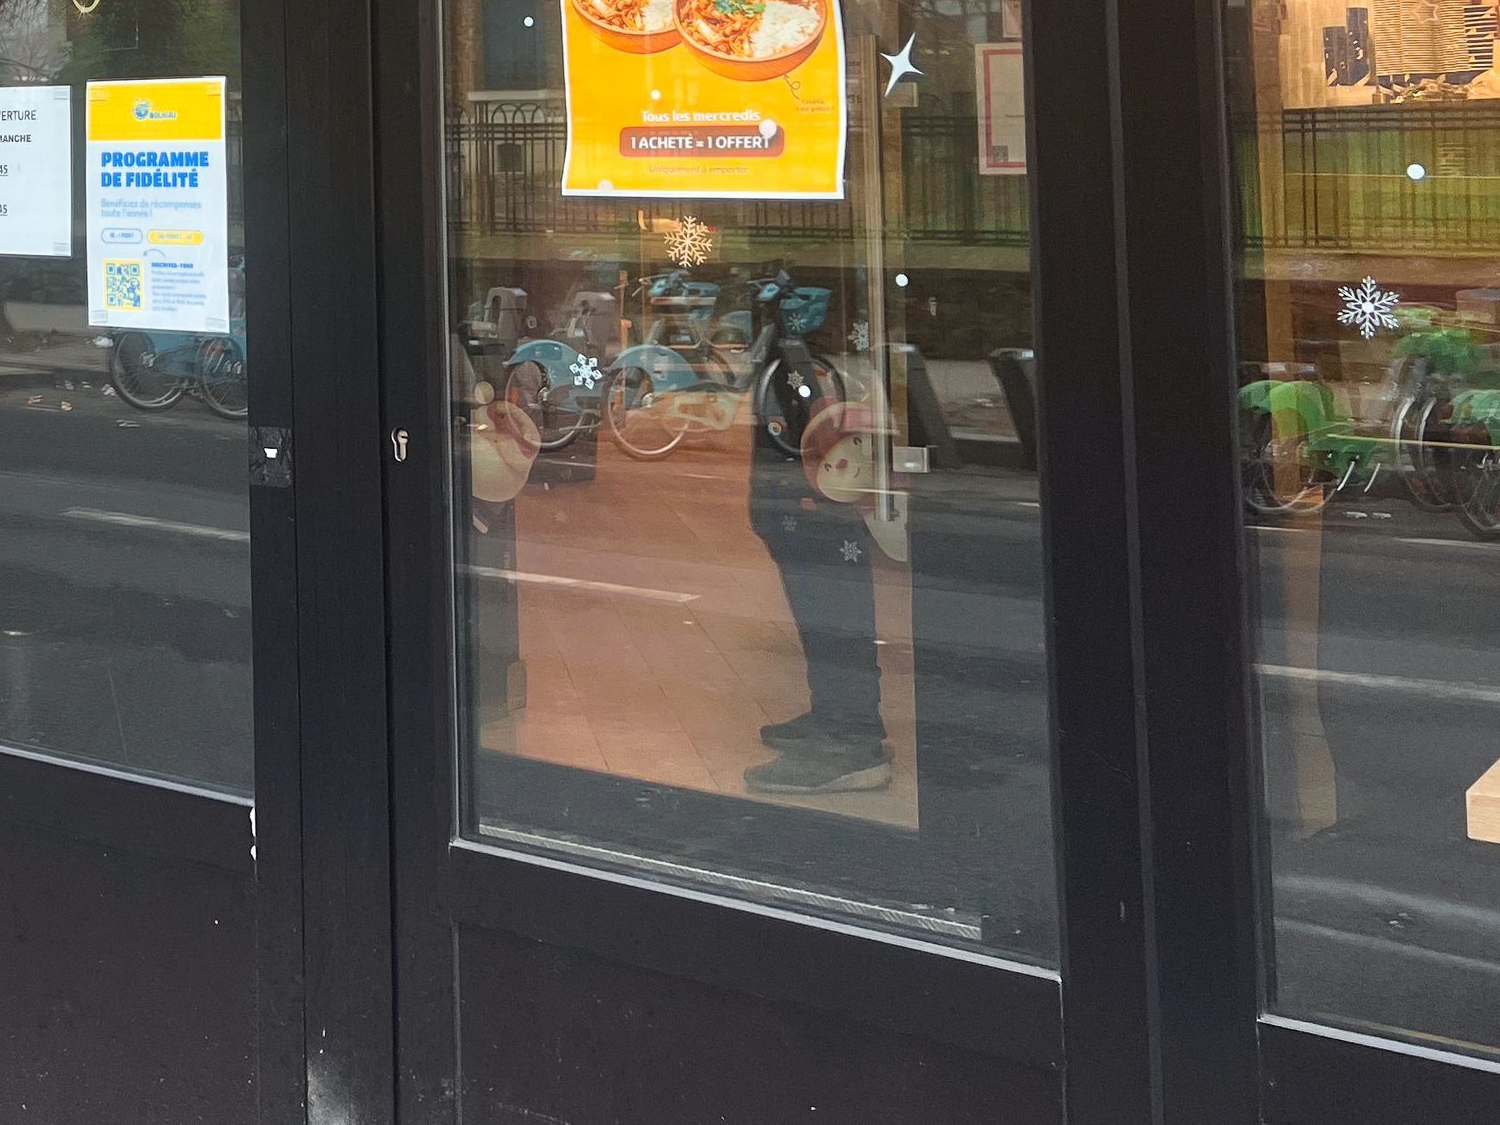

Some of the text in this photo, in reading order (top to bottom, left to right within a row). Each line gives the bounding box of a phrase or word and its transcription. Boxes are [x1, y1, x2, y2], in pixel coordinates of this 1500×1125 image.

[641, 109, 761, 123] Tous les mercredis
[630, 136, 636, 149] 1
[638, 133, 693, 149] ACHETÉ
[707, 136, 713, 149] 1
[715, 136, 770, 149] OFFERT
[101, 151, 210, 167] PROGRAMME
[101, 168, 199, 188] DE FIDÉLITÉ
